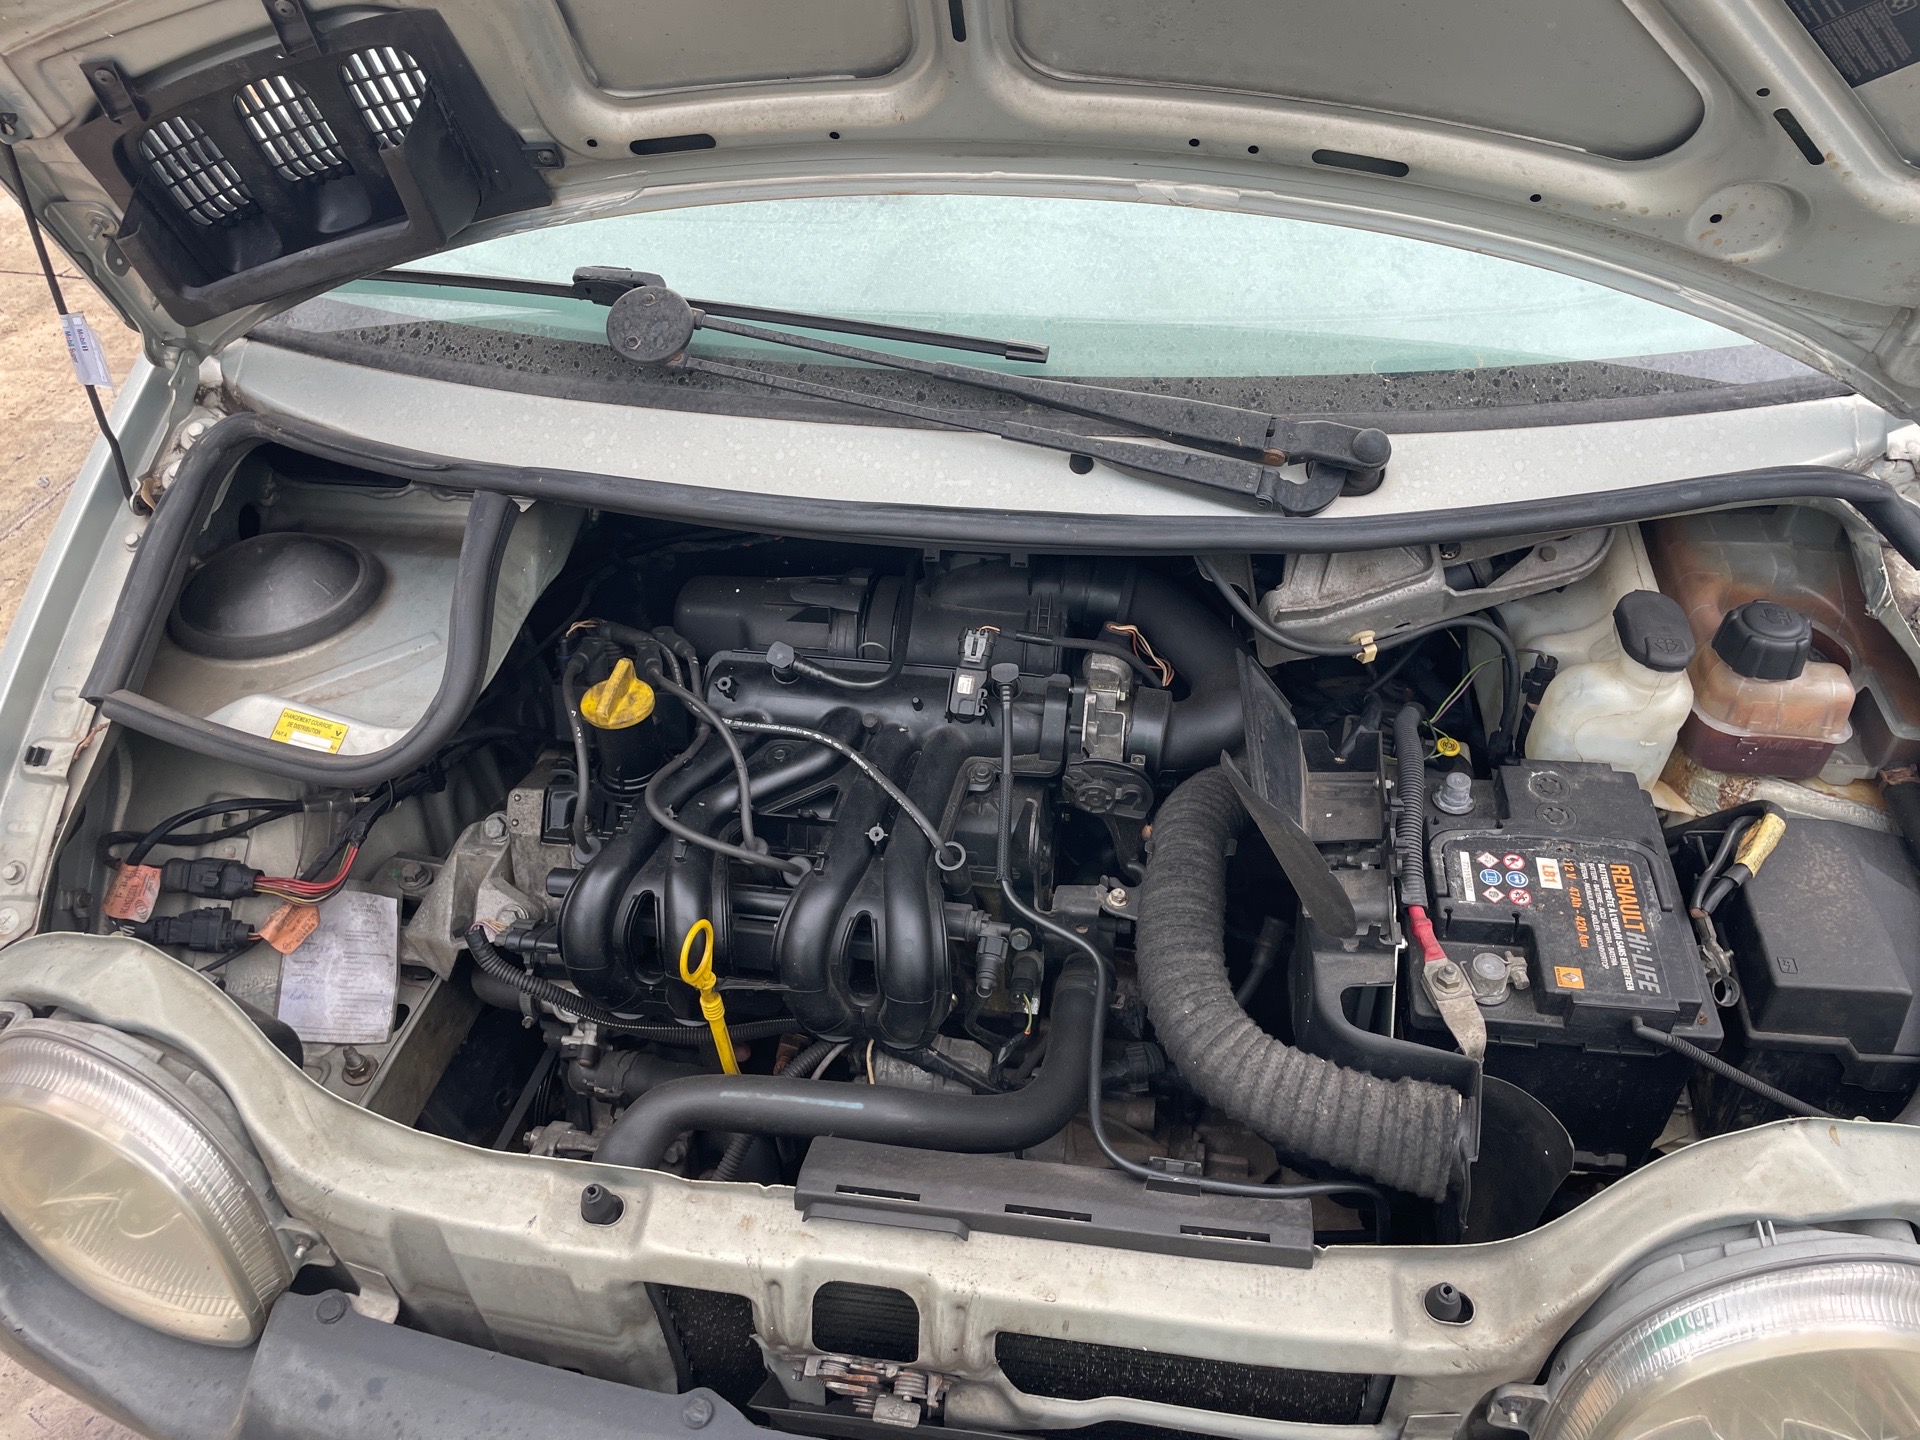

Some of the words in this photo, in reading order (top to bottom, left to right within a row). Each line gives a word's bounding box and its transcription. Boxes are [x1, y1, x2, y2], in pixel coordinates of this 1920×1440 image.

[283, 712, 311, 723] CHANGEMENT
[311, 719, 333, 729] COURROIE
[293, 722, 321, 735] DISTRIBUTION
[1542, 865, 1557, 882] LB1
[1564, 862, 1574, 872] 12
[1598, 864, 1610, 889] BATTERIE
[1568, 887, 1582, 907] 47Ah
[1604, 889, 1616, 907] PRÊTE
[1610, 865, 1646, 932] RENAULT
[1574, 916, 1587, 931] 420
[1609, 914, 1623, 940] L'EMPLOI
[1616, 941, 1627, 956] SANS
[1620, 958, 1635, 990] ENTRETIEN
